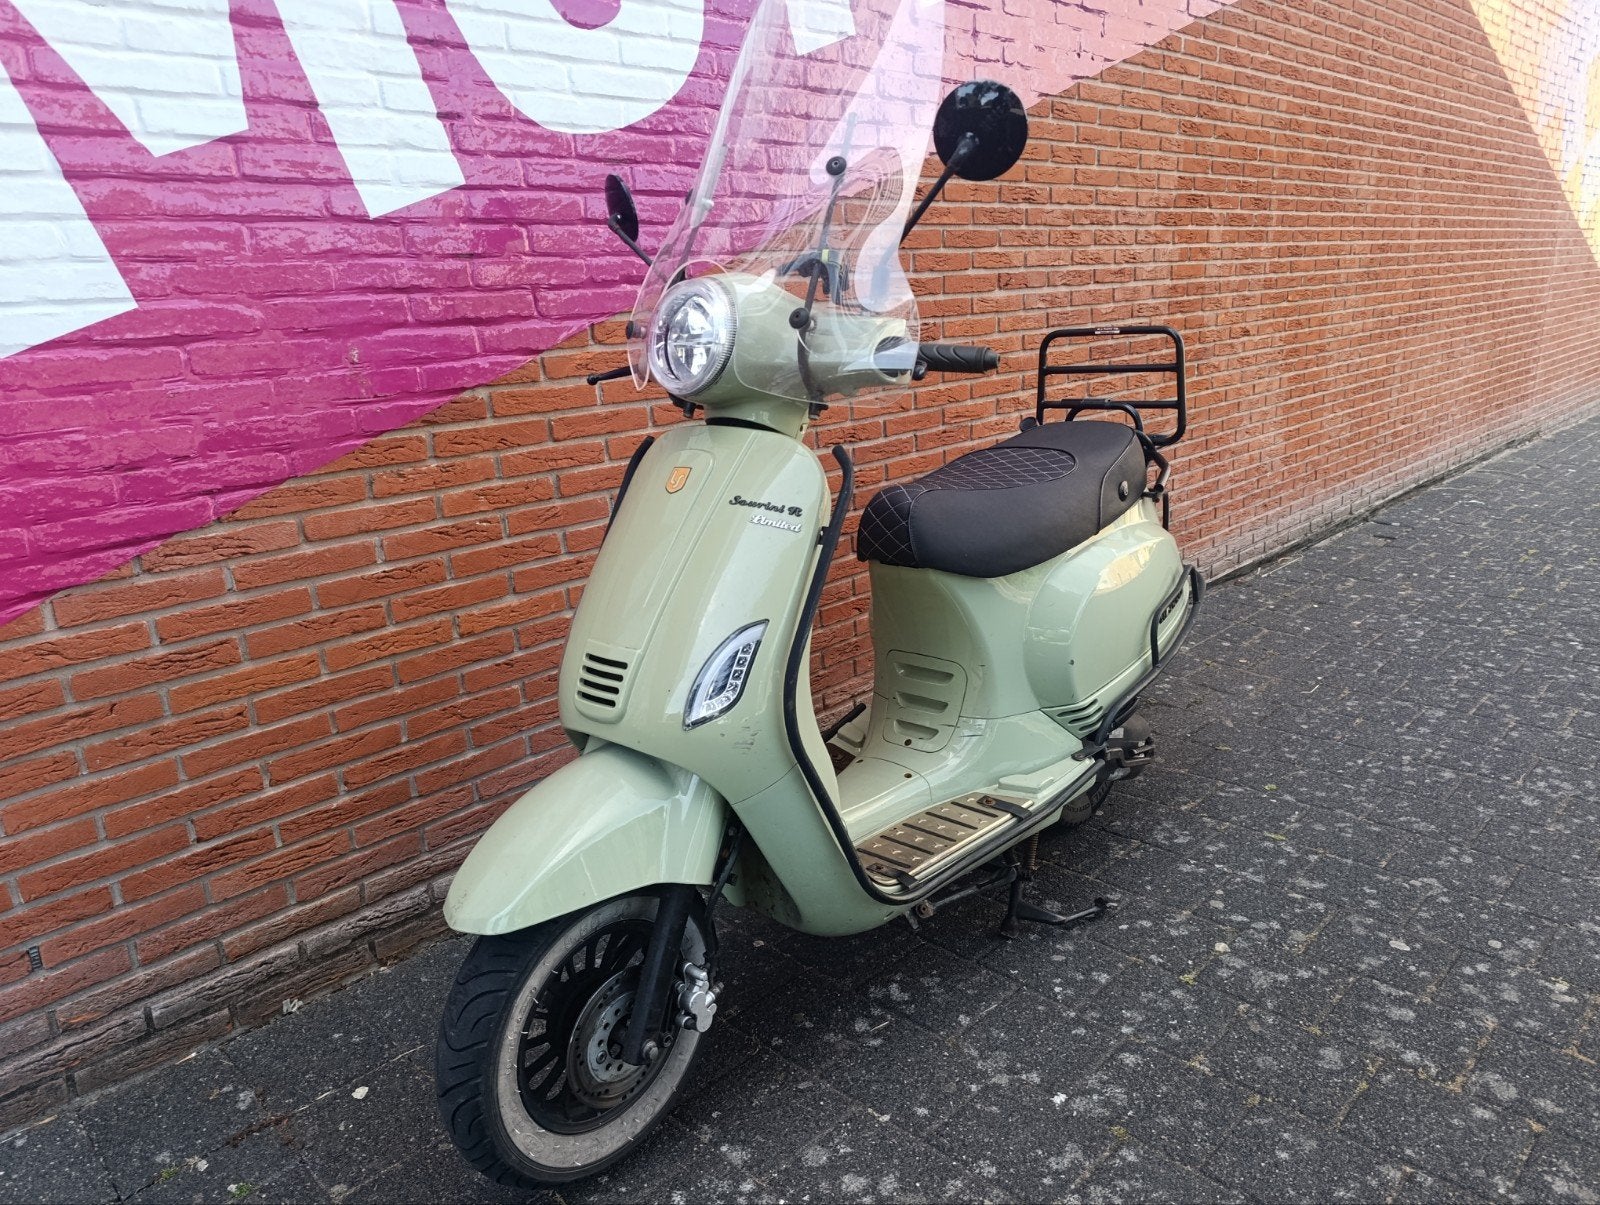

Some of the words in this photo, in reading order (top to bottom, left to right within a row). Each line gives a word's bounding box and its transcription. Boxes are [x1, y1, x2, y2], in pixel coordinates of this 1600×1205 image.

[729, 495, 786, 513] Sourini
[787, 506, 803, 517] R
[750, 515, 802, 533] Limited
